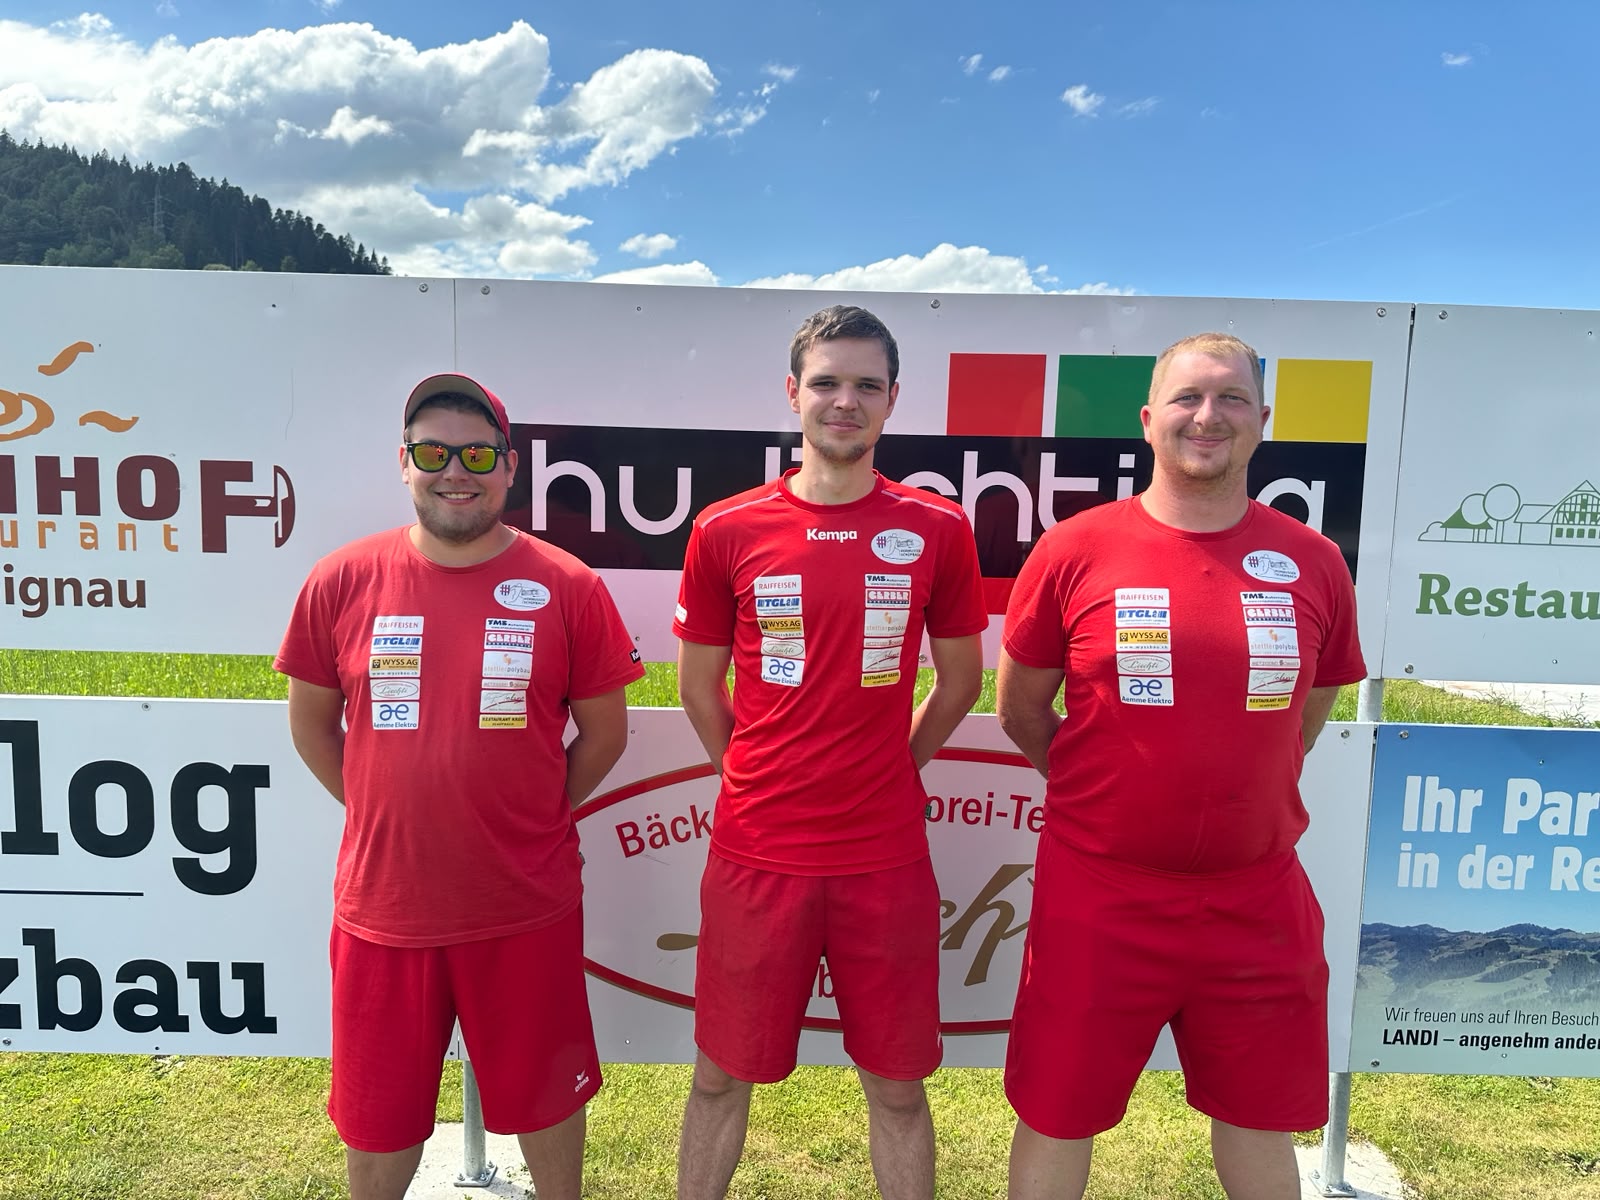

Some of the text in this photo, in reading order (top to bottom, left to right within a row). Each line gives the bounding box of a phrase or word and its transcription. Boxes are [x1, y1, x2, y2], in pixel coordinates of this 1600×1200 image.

[531, 440, 692, 536] hu
[806, 528, 858, 543] Kempa
[3, 563, 147, 618] ignau
[758, 581, 797, 590] RAIFFEISEN
[768, 619, 801, 629] WYSS AG
[1130, 632, 1154, 640] WYSS
[1147, 697, 1173, 705] Elektro
[395, 721, 418, 729] Elektro
[0, 720, 270, 896] log
[1402, 775, 1600, 836] Ihr Par
[1397, 842, 1600, 892] in der Re
[1385, 1007, 1599, 1027] Wir freuen uns auf Ihren Besuch
[1382, 1028, 1439, 1046] LANDI
[1459, 1032, 1549, 1051] angenehm
